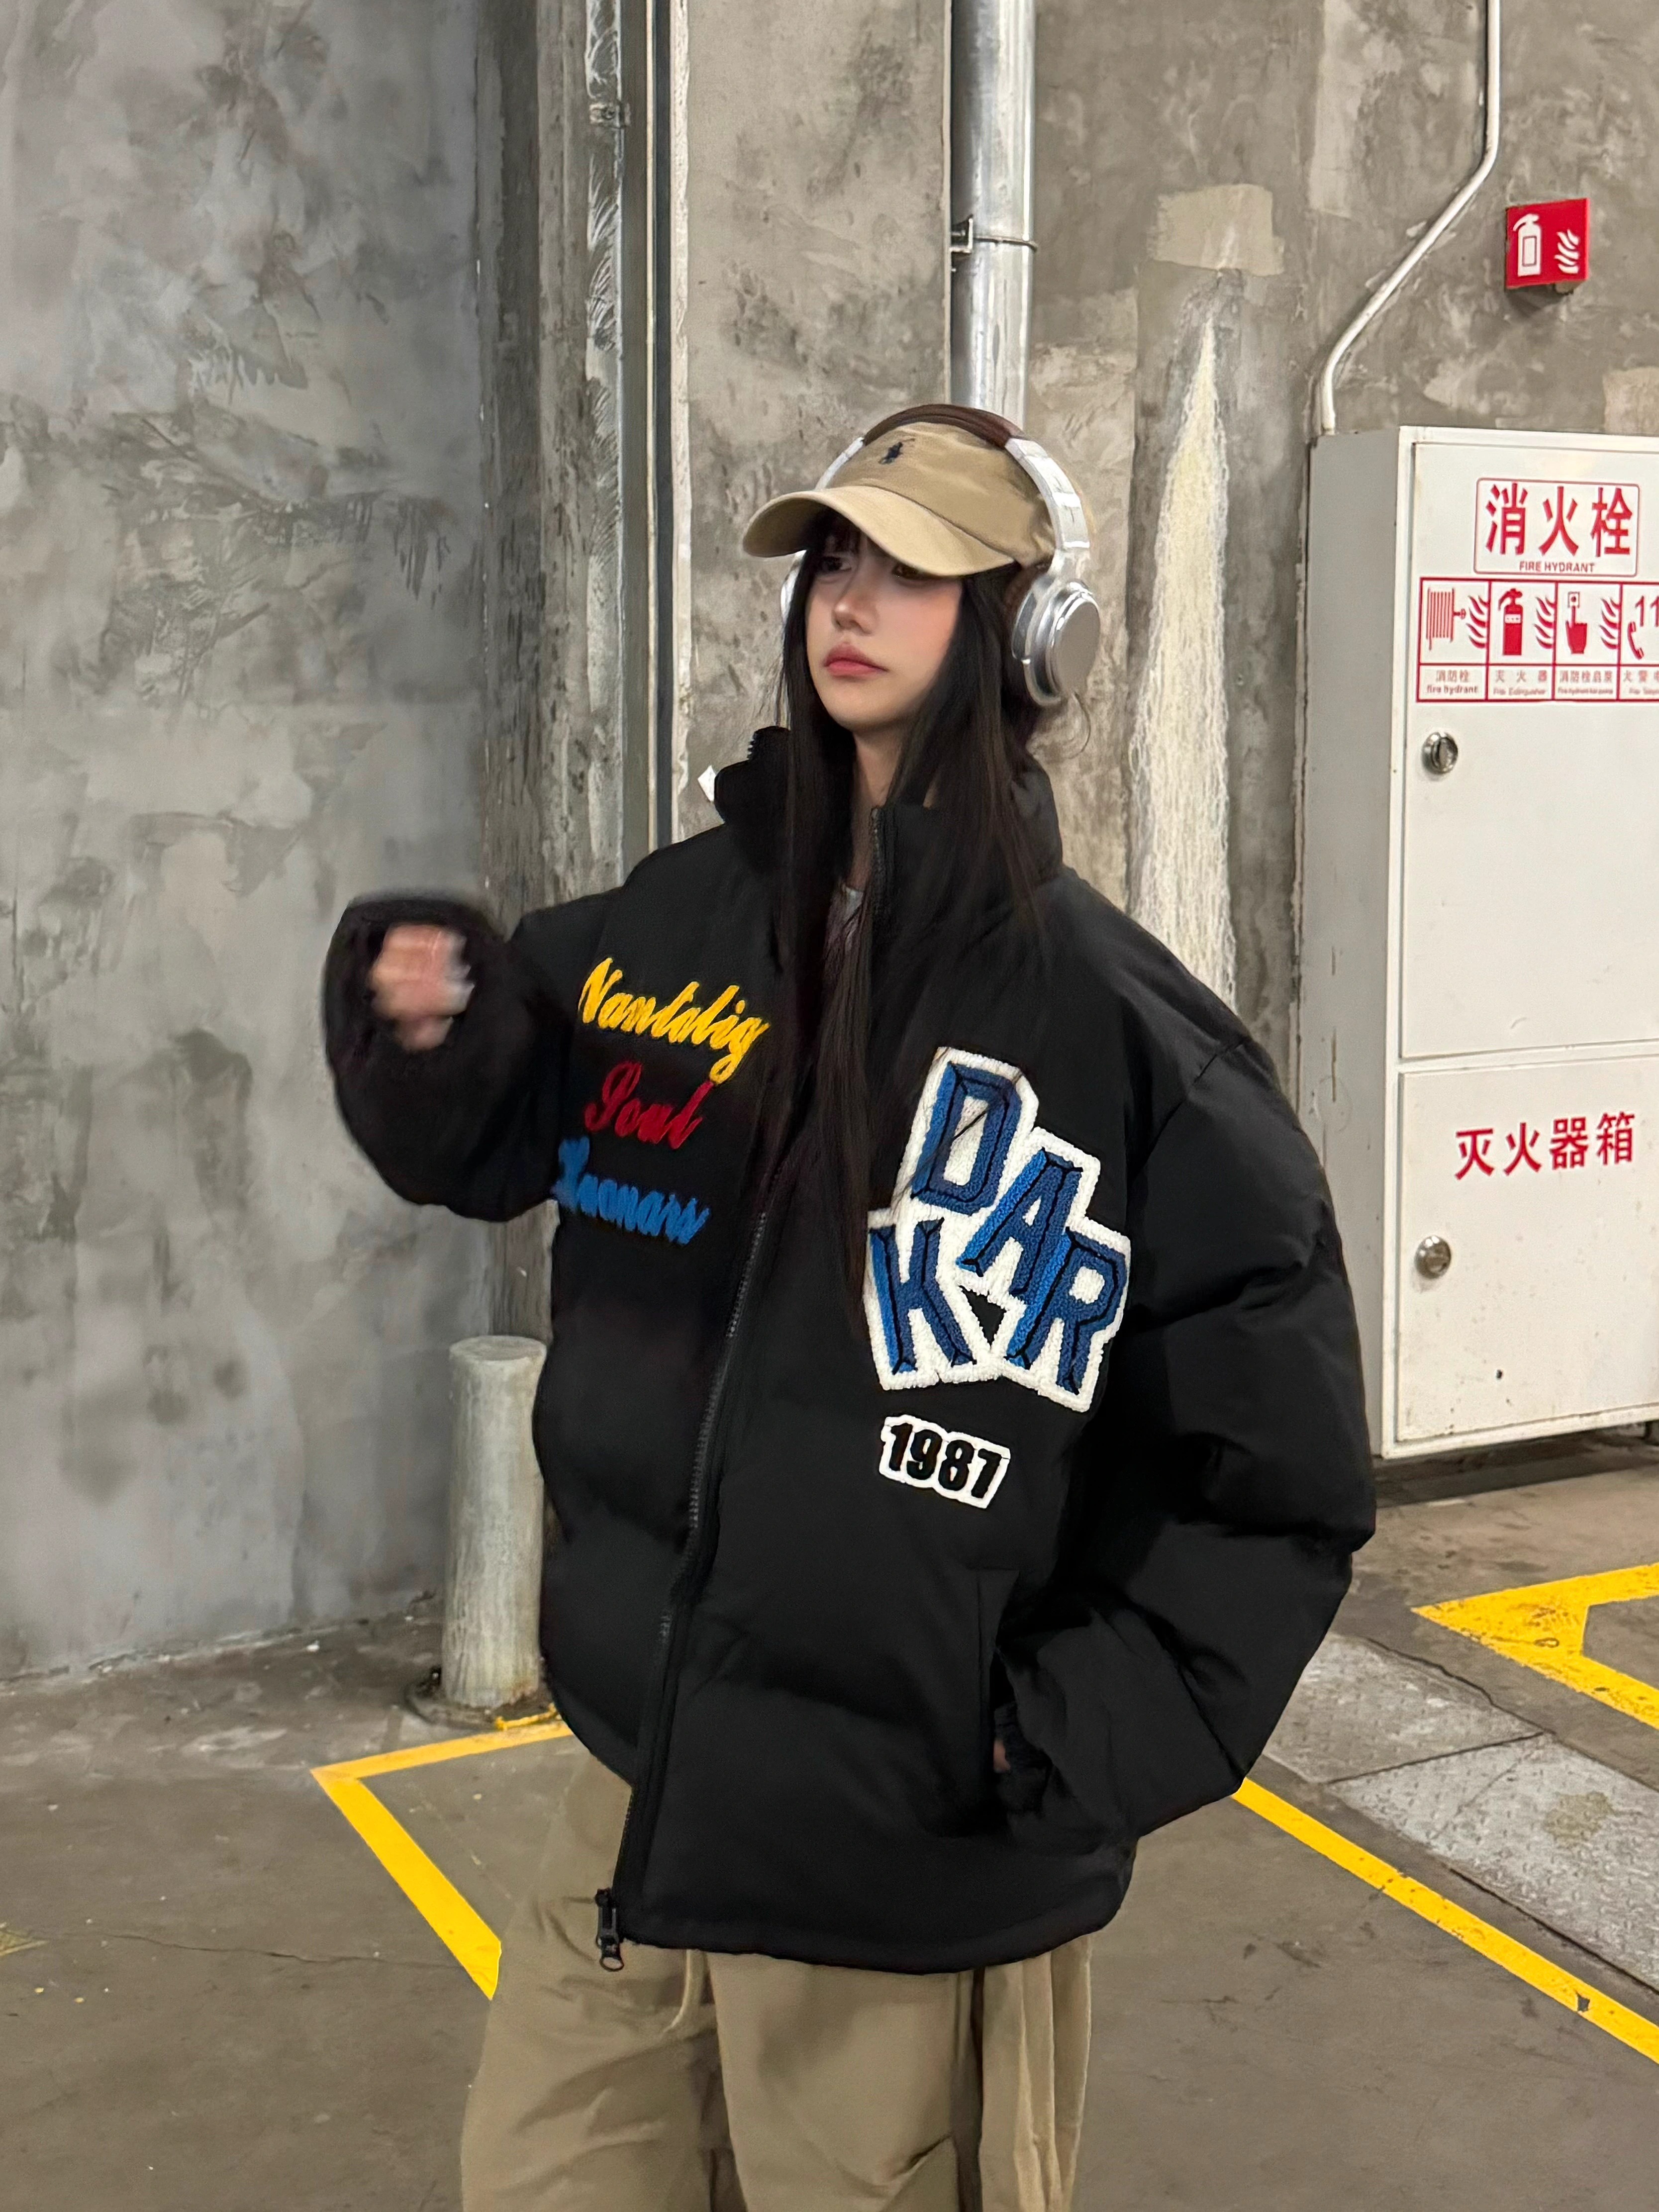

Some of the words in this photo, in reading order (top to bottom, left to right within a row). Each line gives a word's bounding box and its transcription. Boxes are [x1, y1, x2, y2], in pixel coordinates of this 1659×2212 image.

[1485, 482, 1634, 558] 消火栓
[1519, 561, 1542, 572] FIRE
[1544, 562, 1596, 573] HYDRANT
[1455, 1111, 1636, 1181] 灭火器箱
[888, 1422, 1002, 1499] 1987
